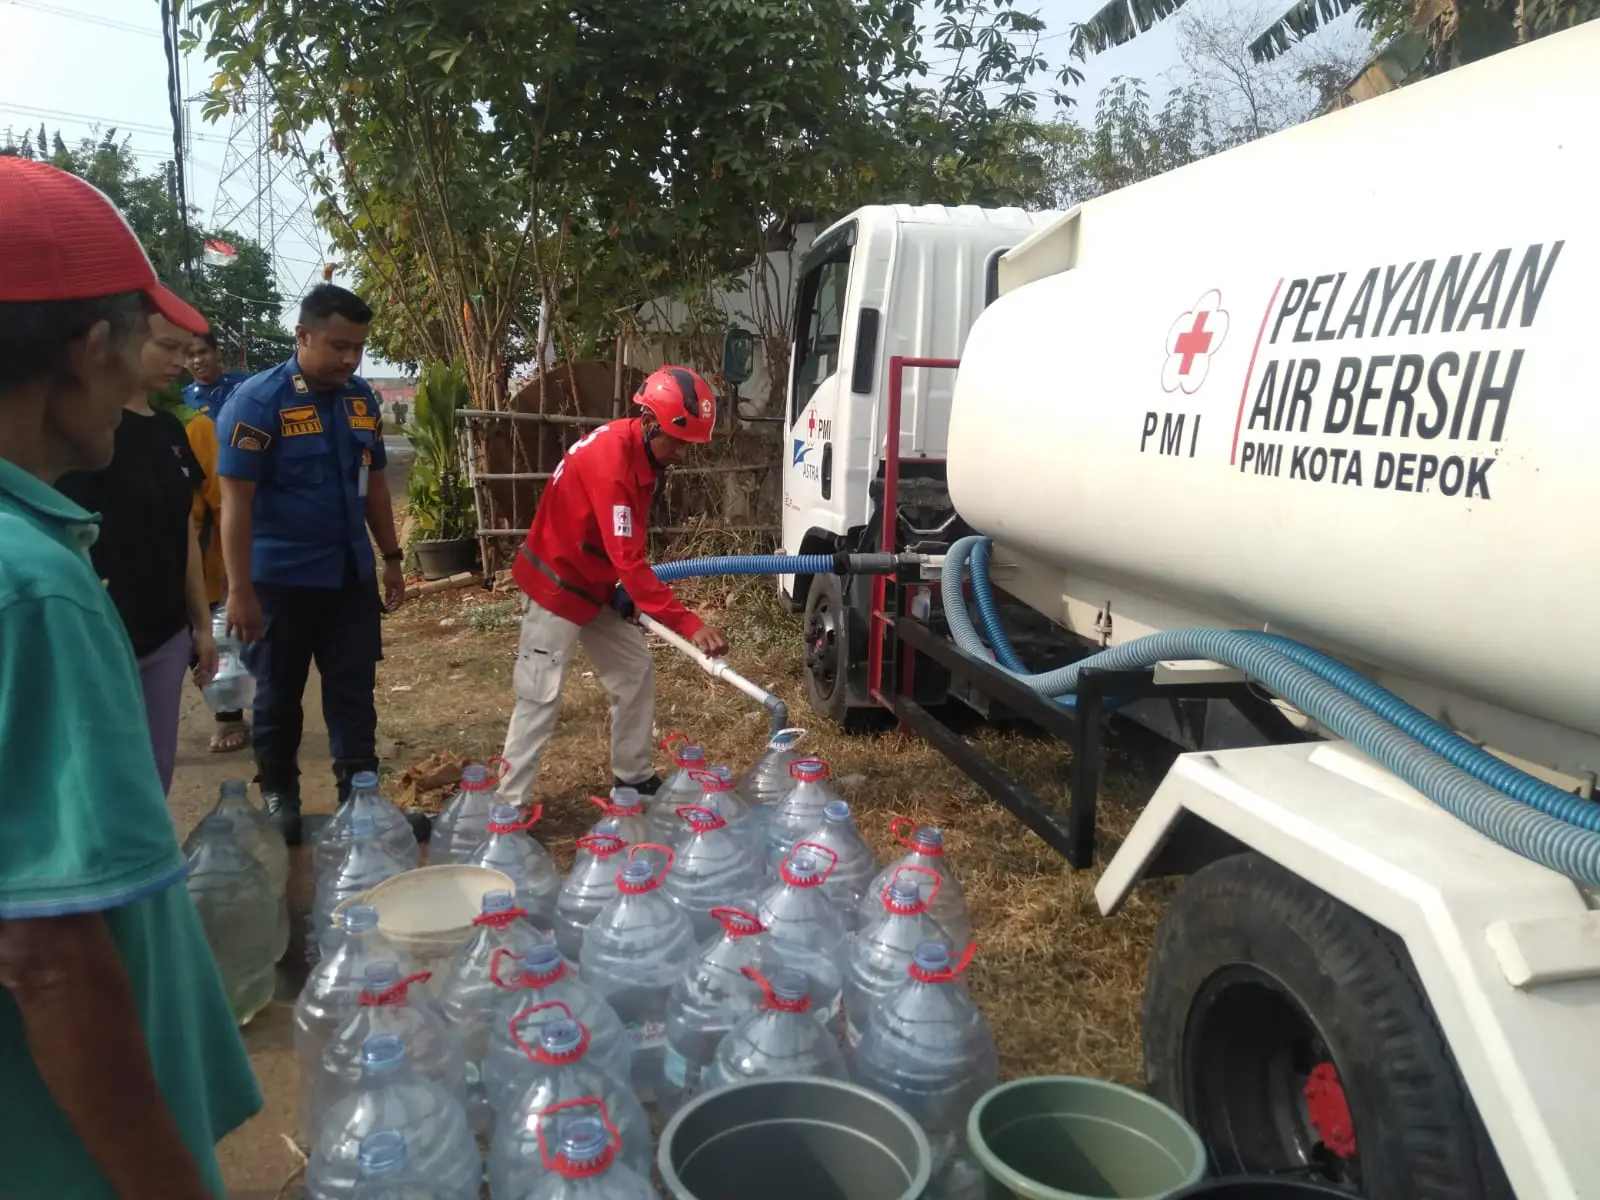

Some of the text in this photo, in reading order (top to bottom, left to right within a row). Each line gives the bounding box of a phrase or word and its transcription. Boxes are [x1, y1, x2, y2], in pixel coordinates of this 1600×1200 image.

[1269, 240, 1566, 345] PELAYANAN
[1247, 349, 1525, 442] AIR BERSIH
[818, 419, 832, 441] PMI
[1140, 411, 1202, 458] PMI
[803, 464, 819, 481] ASTRA
[1240, 442, 1496, 500] PMI KOTA DEPOK
